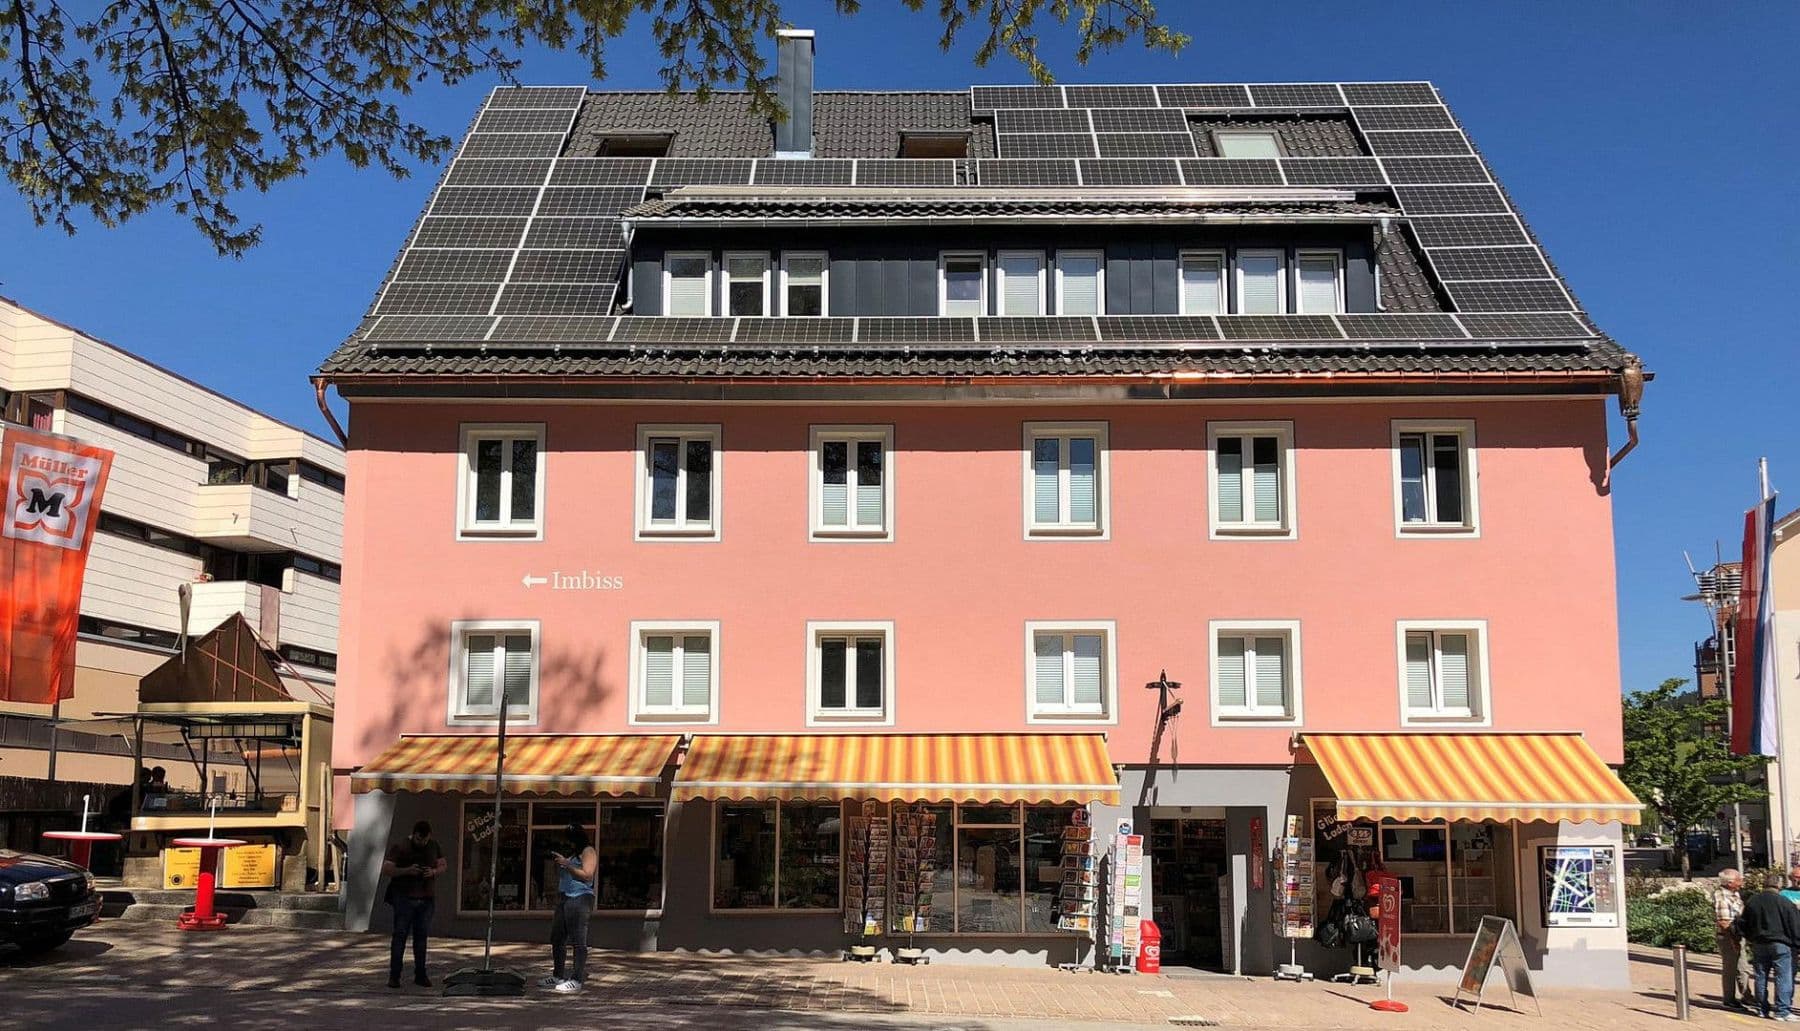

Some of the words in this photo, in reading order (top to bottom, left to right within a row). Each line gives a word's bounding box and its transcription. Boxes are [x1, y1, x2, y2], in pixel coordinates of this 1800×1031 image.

[21, 453, 88, 478] Müller
[26, 488, 65, 517] M
[551, 570, 624, 589] Imbiss
[1317, 814, 1338, 830] Glüc
